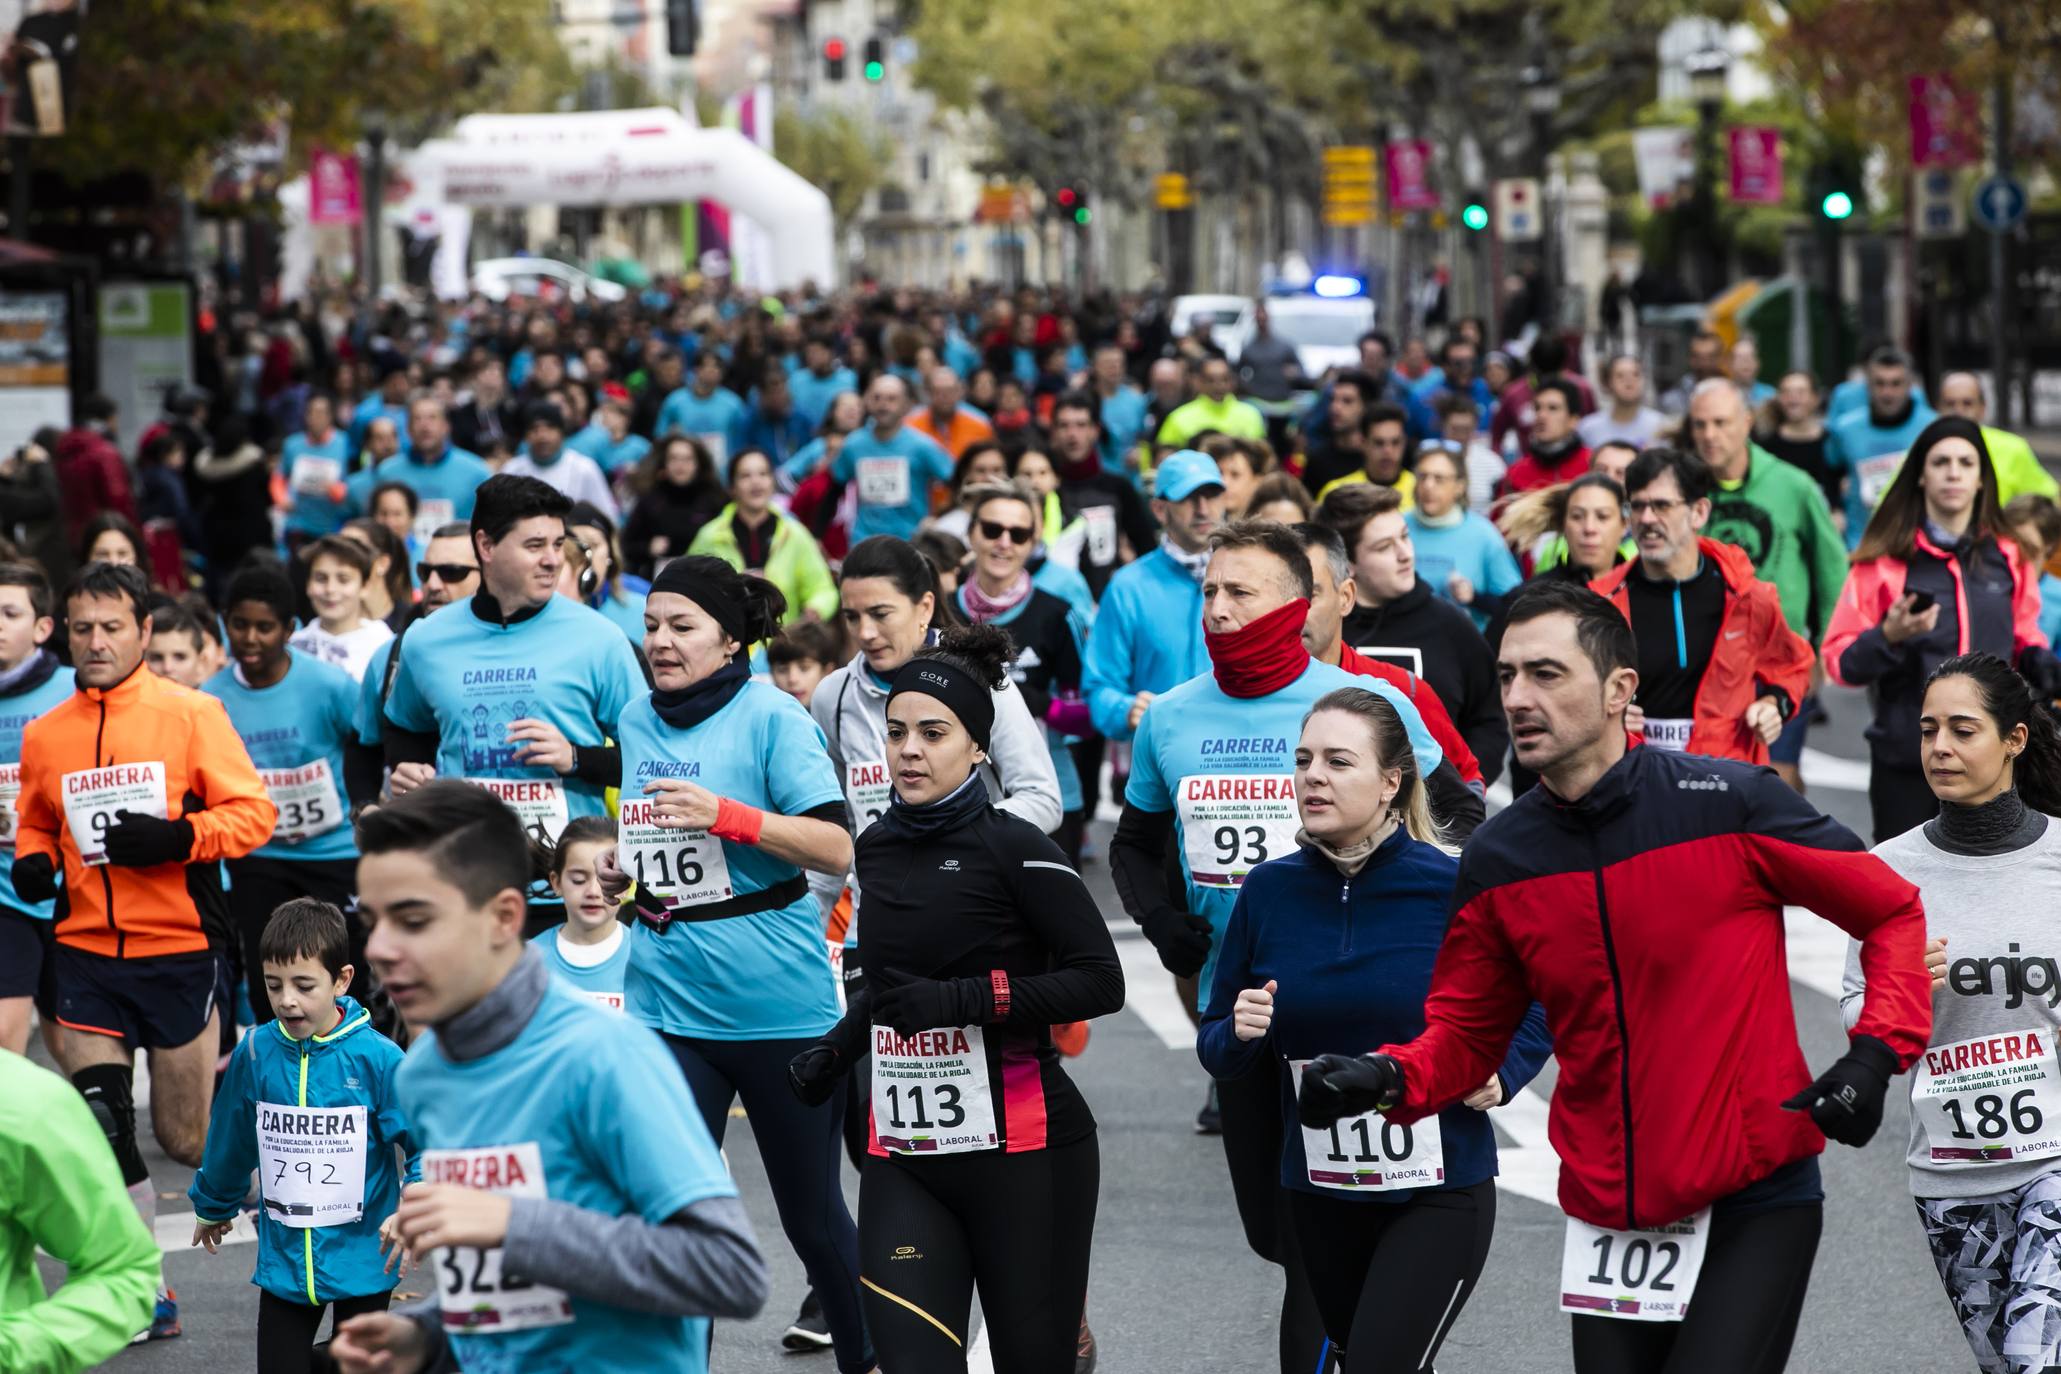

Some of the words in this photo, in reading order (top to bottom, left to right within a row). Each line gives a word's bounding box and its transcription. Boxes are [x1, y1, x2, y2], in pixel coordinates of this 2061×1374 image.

[463, 667, 537, 685] CARRERA
[920, 671, 949, 686] GORE
[1200, 738, 1288, 755] CARRERA
[262, 765, 324, 786] ARRERA
[637, 761, 700, 777] CARRERA
[68, 766, 154, 794] CARRERA
[1188, 778, 1295, 801] CARRERA
[1214, 826, 1268, 865] 93
[634, 847, 703, 887] 116
[681, 889, 719, 901] LABORAL
[1949, 943, 2061, 1009] enjoy
[877, 1030, 970, 1056] CARRERA
[936, 1060, 963, 1068] FAMILIA
[1926, 1033, 2045, 1076] CARRERA
[898, 1071, 928, 1079] SALUDABLE
[1957, 1070, 1996, 1083] EDUCACIÓN,
[2009, 1064, 2038, 1075] FAMILIA
[1959, 1079, 2000, 1091] SALUDABLE
[2002, 1078, 2011, 1086] DE
[2013, 1076, 2022, 1084] LA
[2024, 1072, 2046, 1082] RIOJA
[886, 1084, 965, 1128] 113
[1942, 1089, 2043, 1139] 186
[262, 1110, 356, 1135] CARRERA
[283, 1146, 315, 1154] SALUDABLE
[940, 1136, 982, 1145] LABORAL
[1327, 1118, 1414, 1162] 110
[2015, 1140, 2060, 1153] LABORAL
[273, 1159, 343, 1186] 792
[1386, 1169, 1429, 1180] LABORAL
[1588, 1234, 1680, 1291] 102
